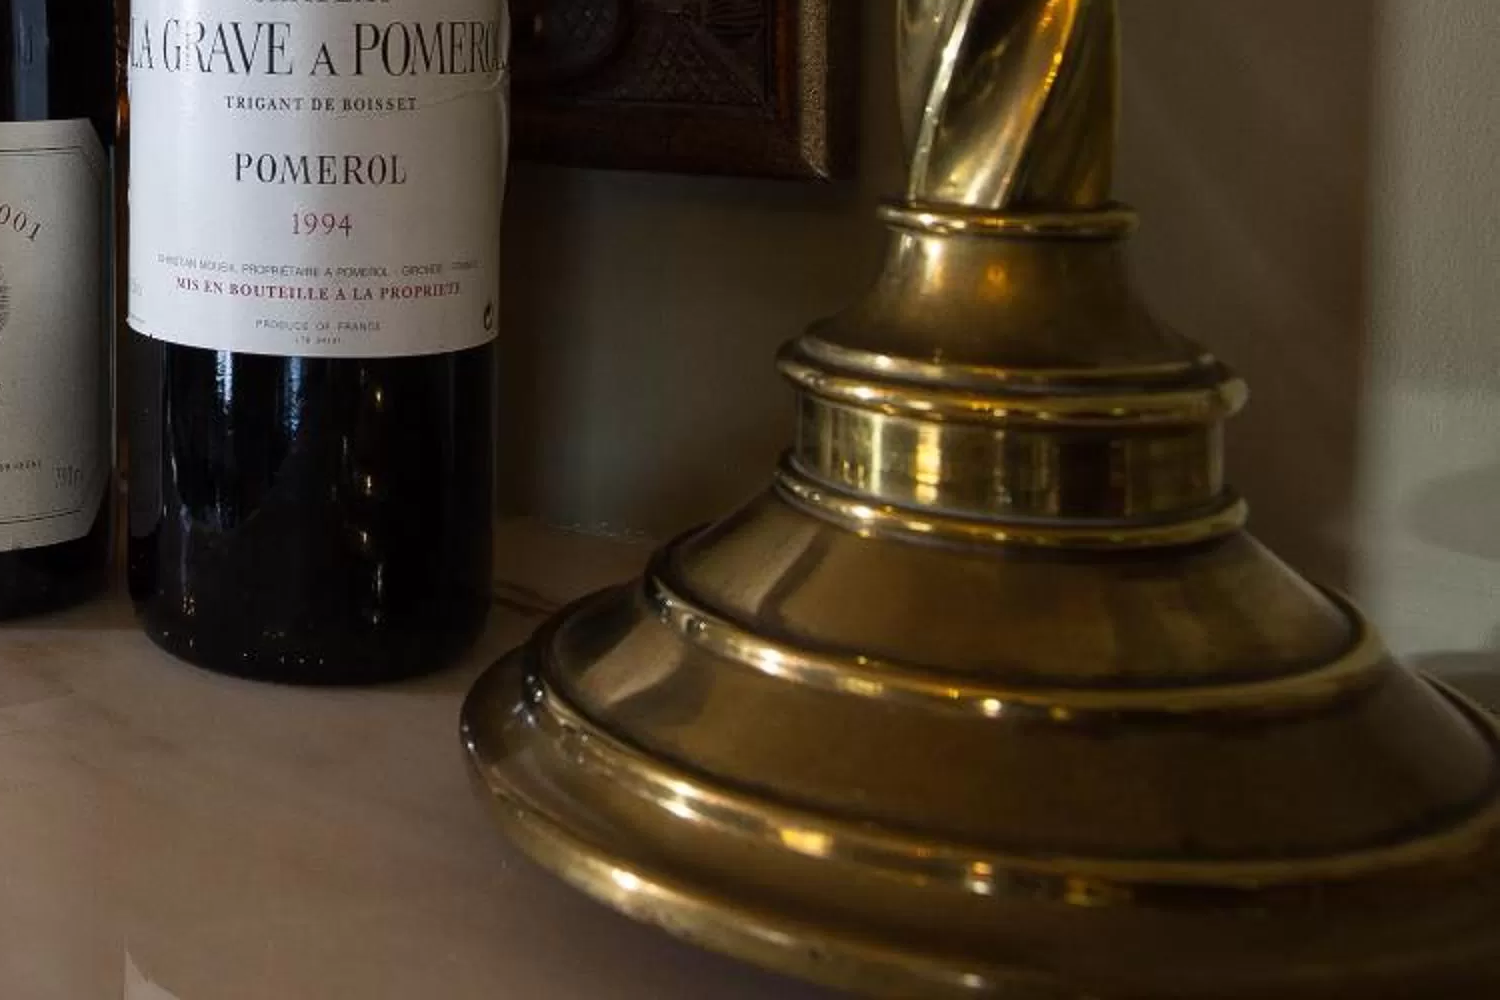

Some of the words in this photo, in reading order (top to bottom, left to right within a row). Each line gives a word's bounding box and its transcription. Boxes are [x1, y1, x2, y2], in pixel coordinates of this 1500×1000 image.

[162, 17, 294, 76] GRAVE
[309, 42, 341, 76] A
[225, 94, 304, 111] TRIGANT
[311, 96, 336, 111] DE
[342, 96, 420, 111] BOISSET
[234, 151, 409, 186] POMEROL
[290, 212, 354, 238] 1994
[175, 276, 199, 292] MIS
[203, 280, 224, 295] EN
[229, 282, 329, 301] BOUTEILLE
[334, 286, 347, 301] A
[352, 285, 374, 301] LA
[315, 320, 331, 332] OF
